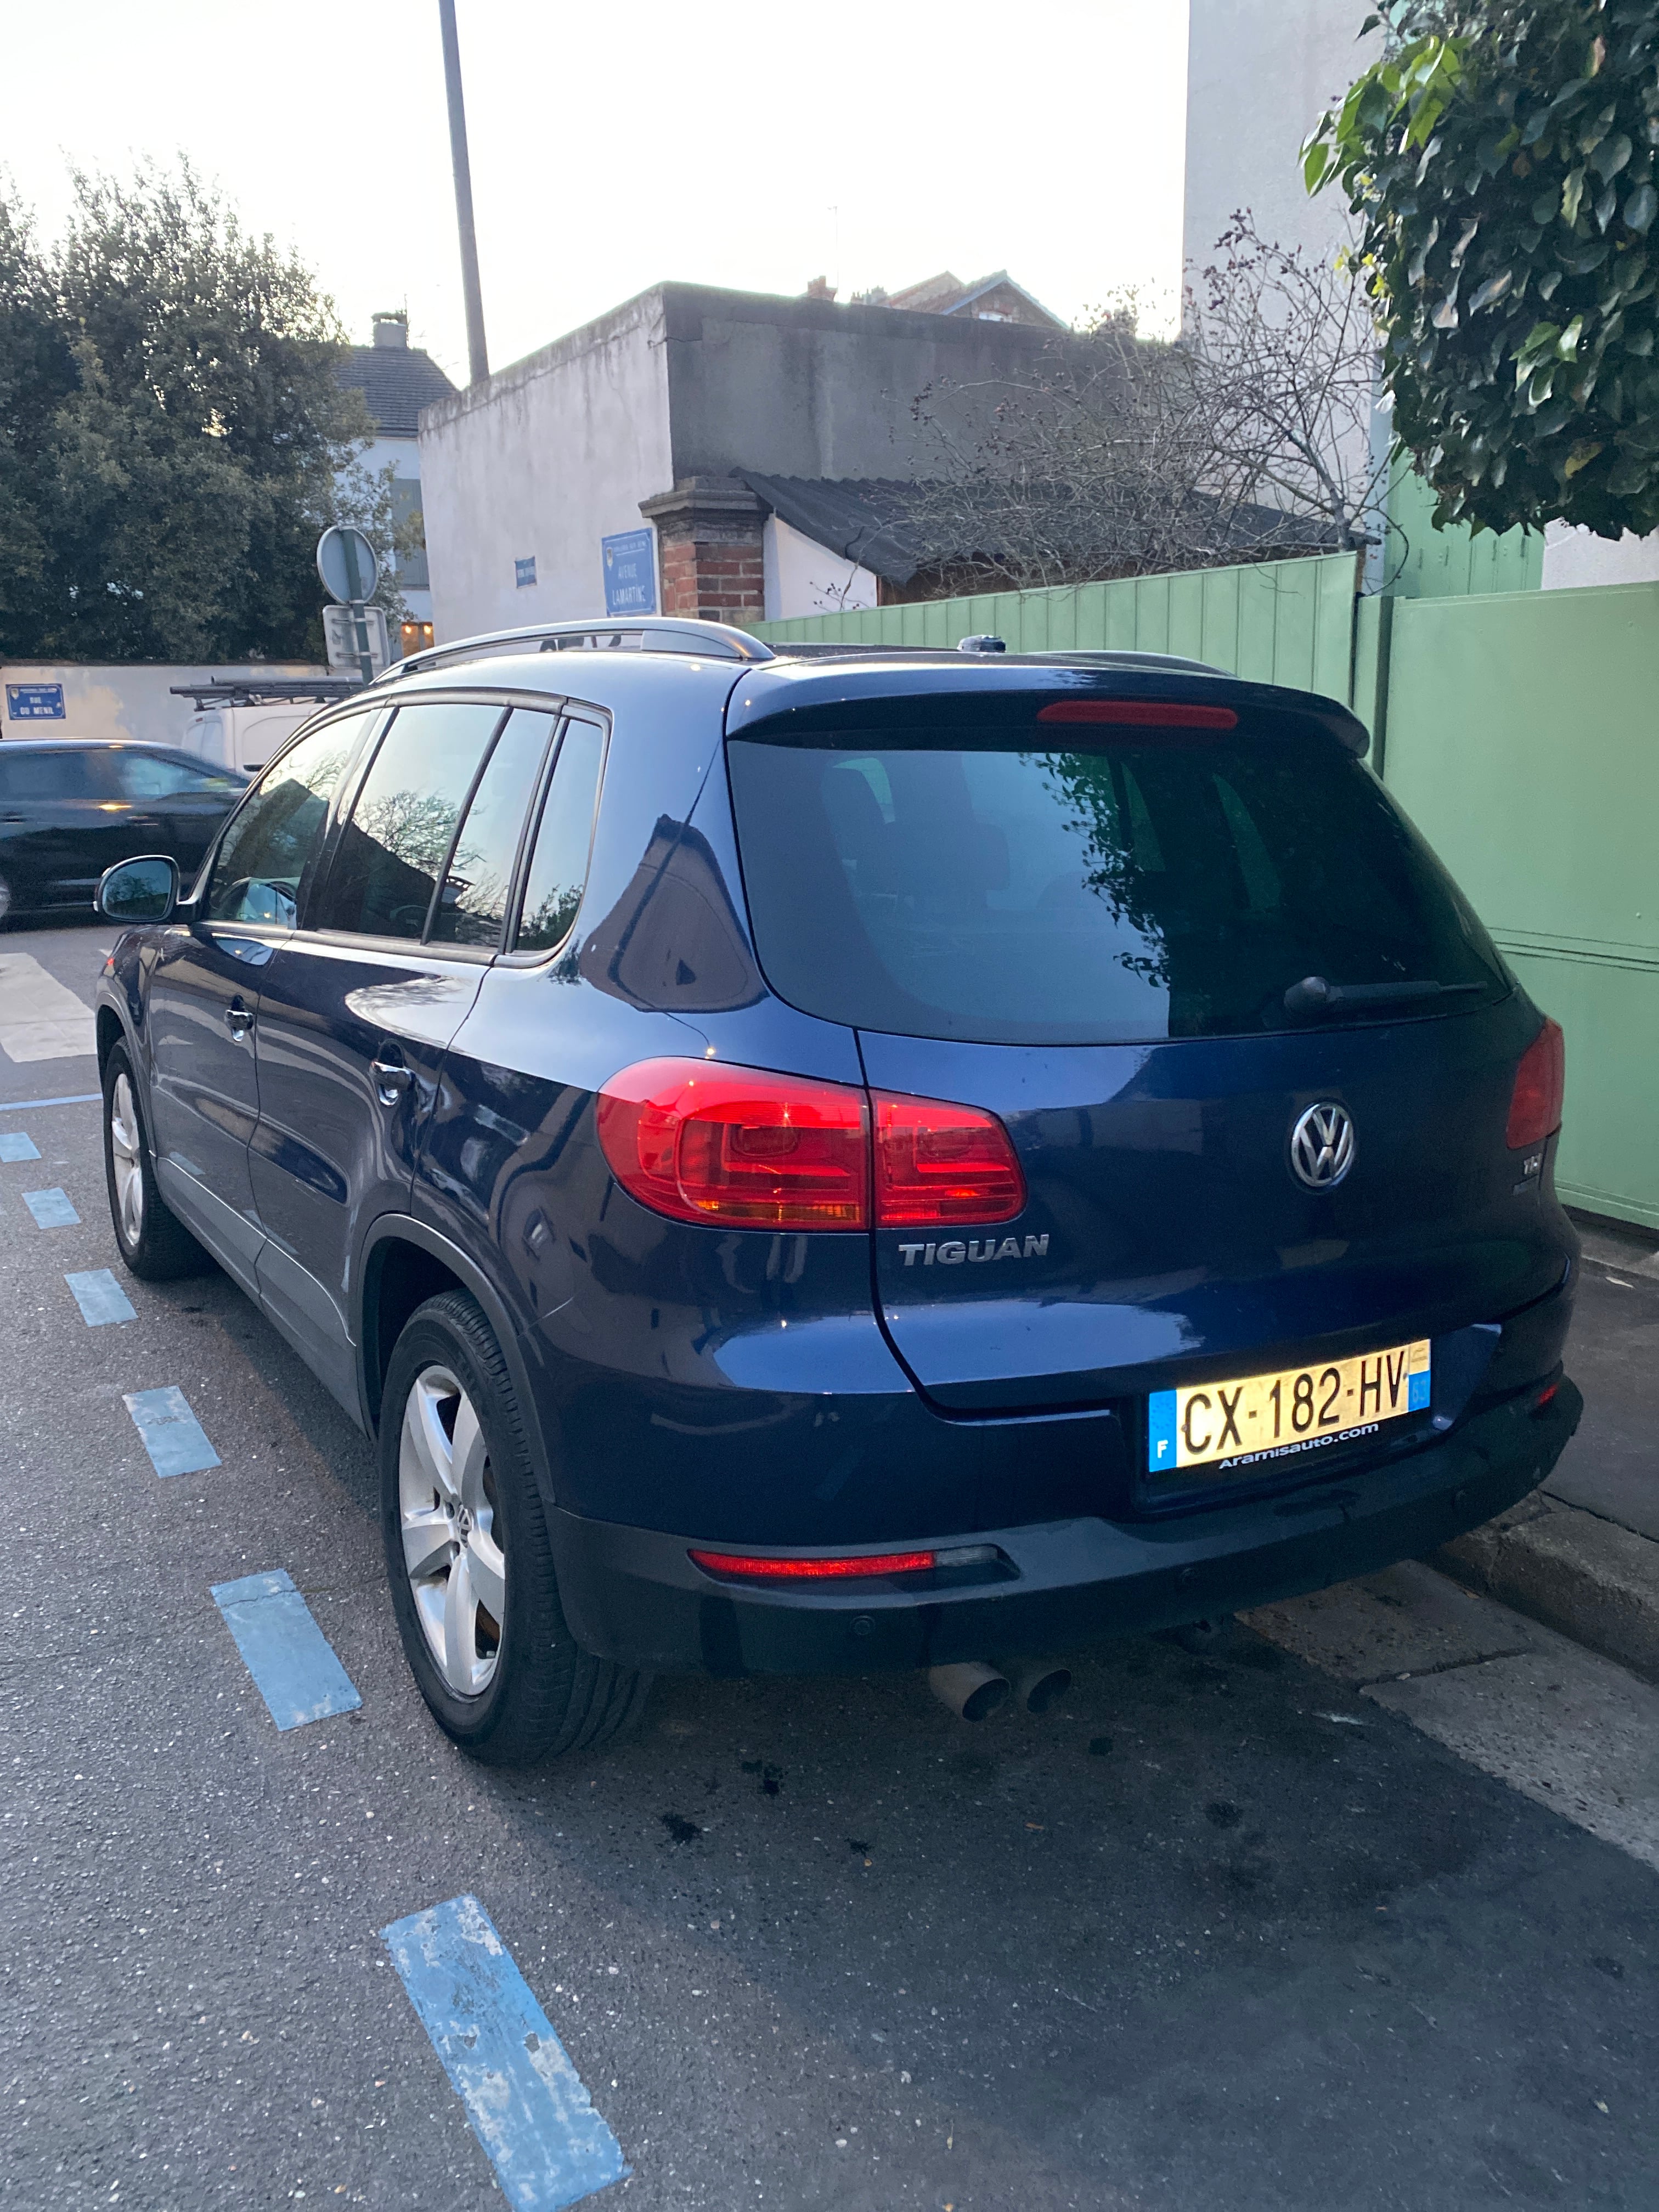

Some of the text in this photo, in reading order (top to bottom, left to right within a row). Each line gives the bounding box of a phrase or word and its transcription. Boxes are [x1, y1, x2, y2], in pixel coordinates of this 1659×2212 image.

[618, 563, 637, 579] AVENUE
[612, 584, 646, 605] LAMARTINE
[898, 1234, 1049, 1266] TIGUAN
[1156, 1439, 1169, 1458] F
[1184, 1350, 1405, 1455] CX-182-HV
[1218, 1421, 1379, 1470] Aramisauto.com
